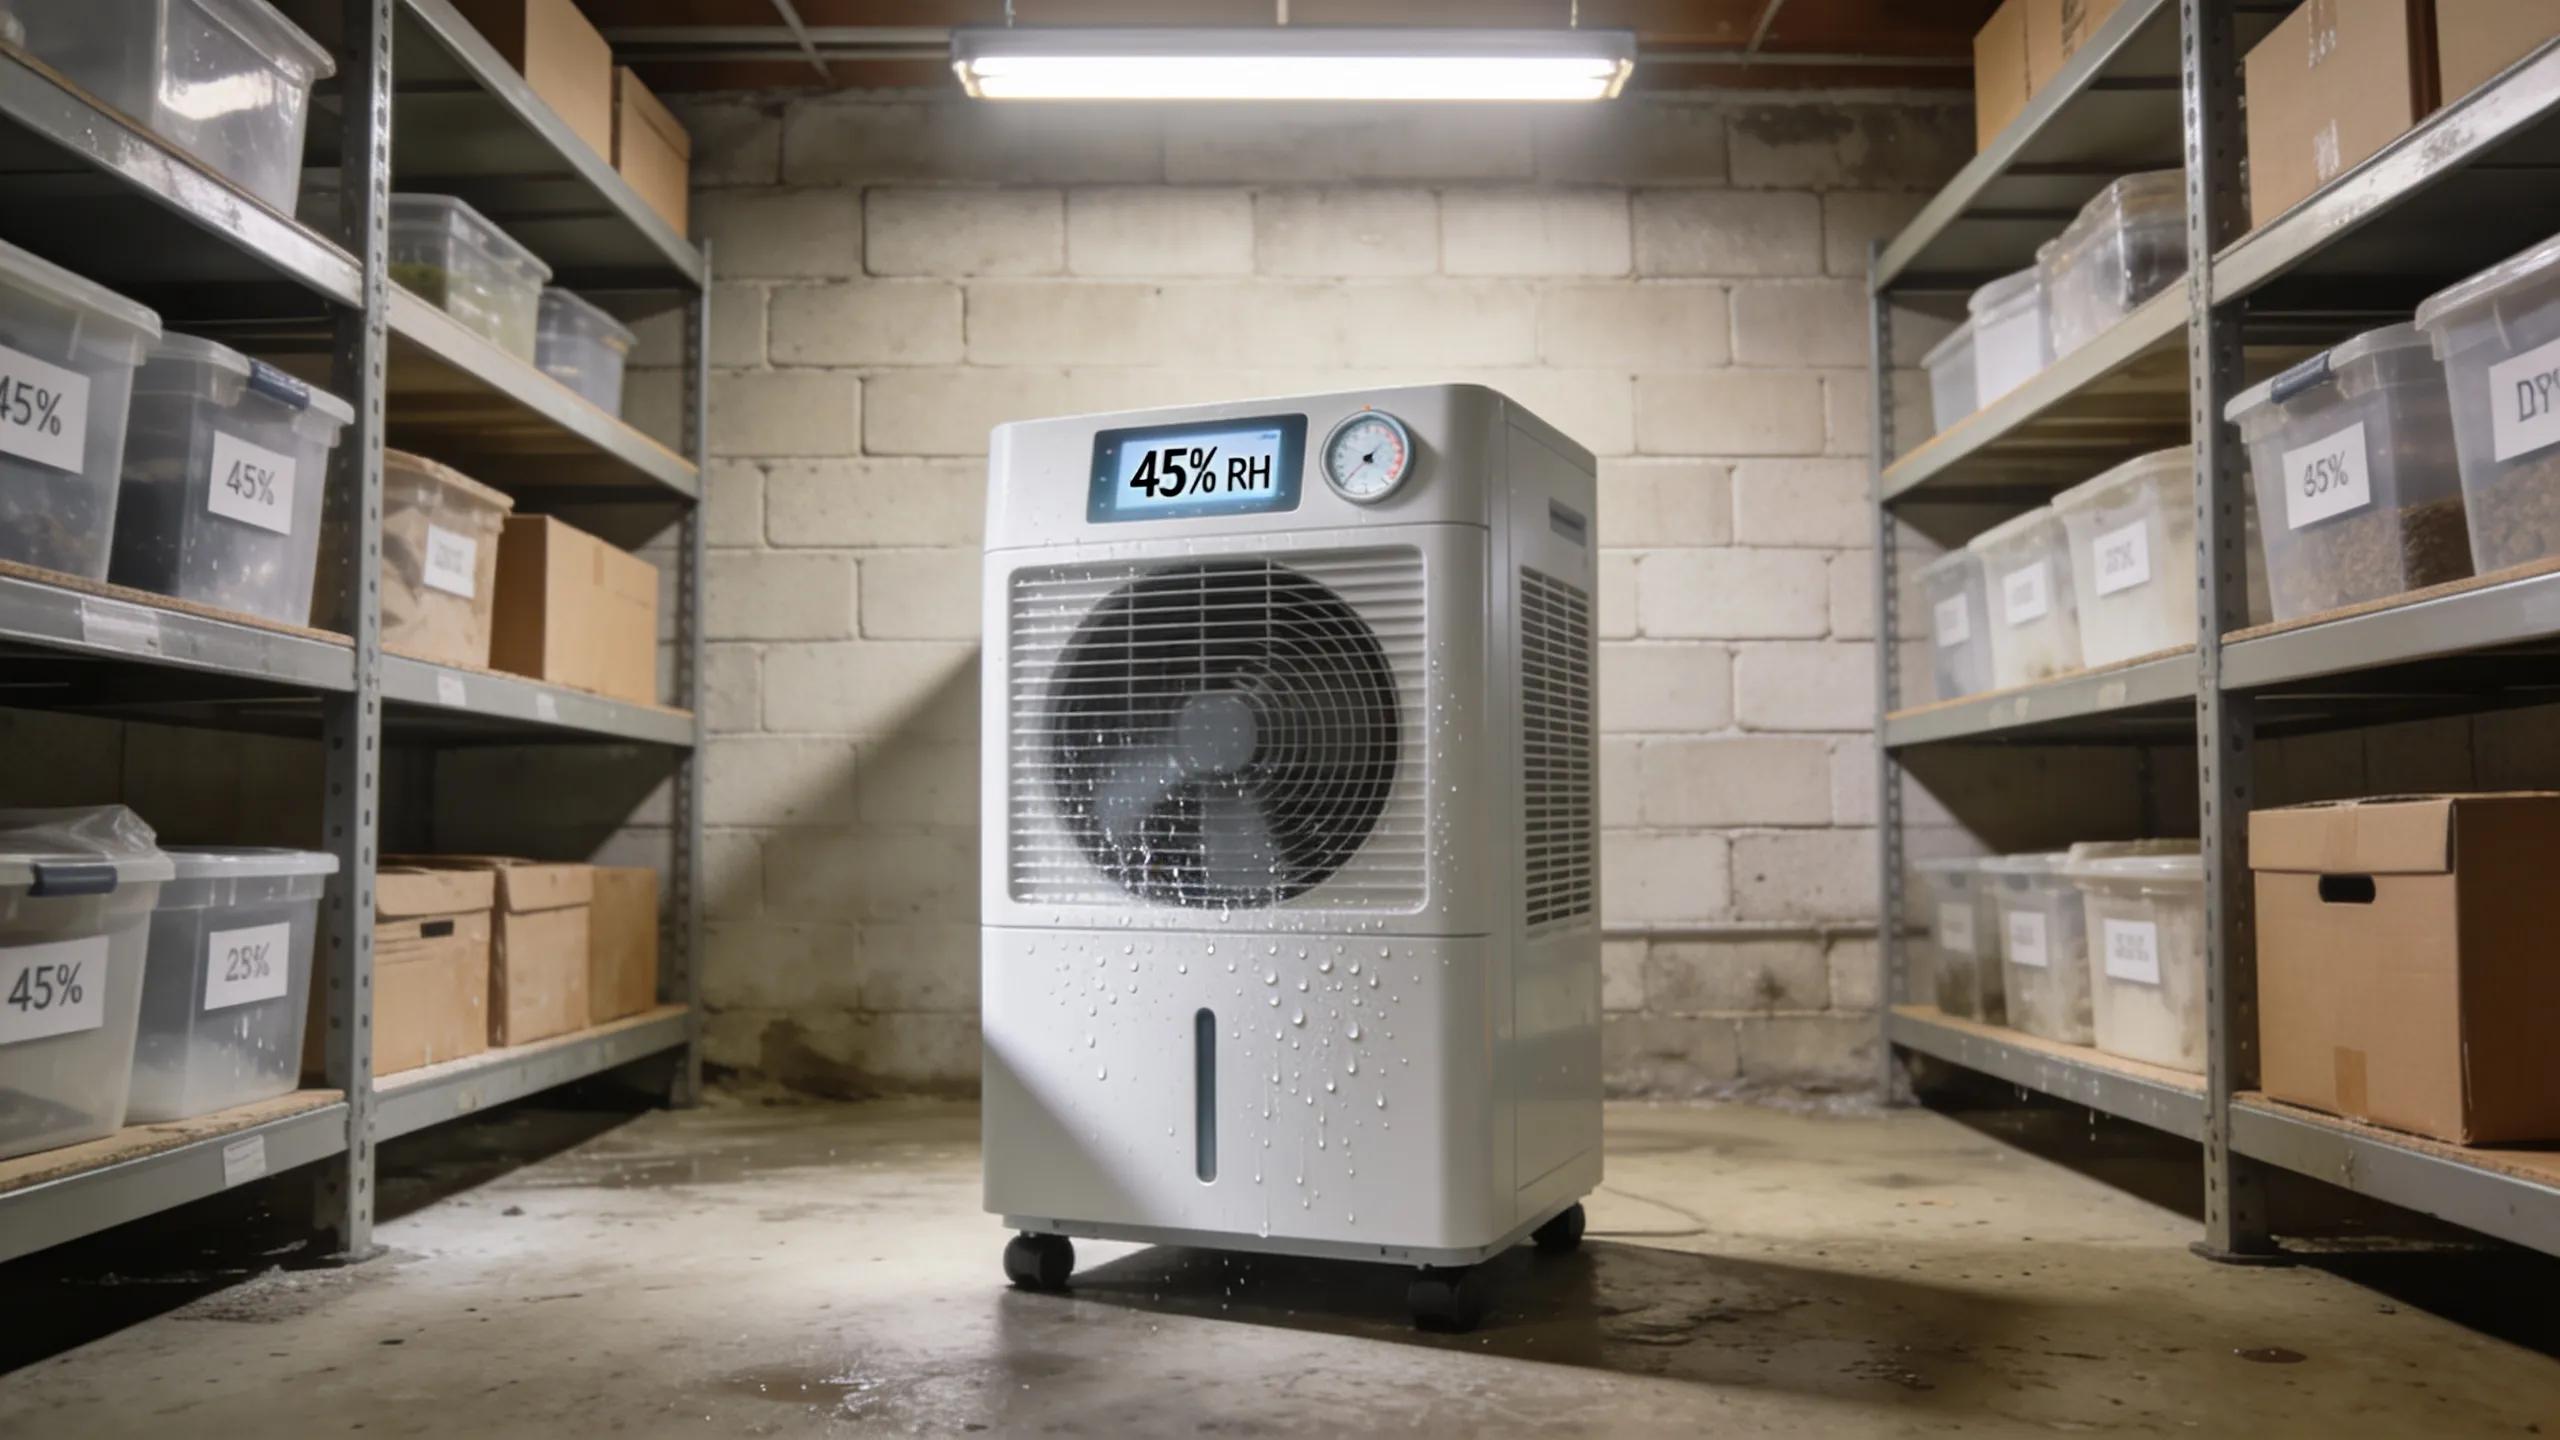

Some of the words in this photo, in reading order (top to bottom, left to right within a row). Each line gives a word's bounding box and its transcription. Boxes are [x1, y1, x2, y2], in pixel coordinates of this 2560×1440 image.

[226, 459, 275, 506] 45%
[1130, 446, 1217, 497] 45%
[1227, 455, 1271, 492] RH
[8, 961, 82, 1012] 45%
